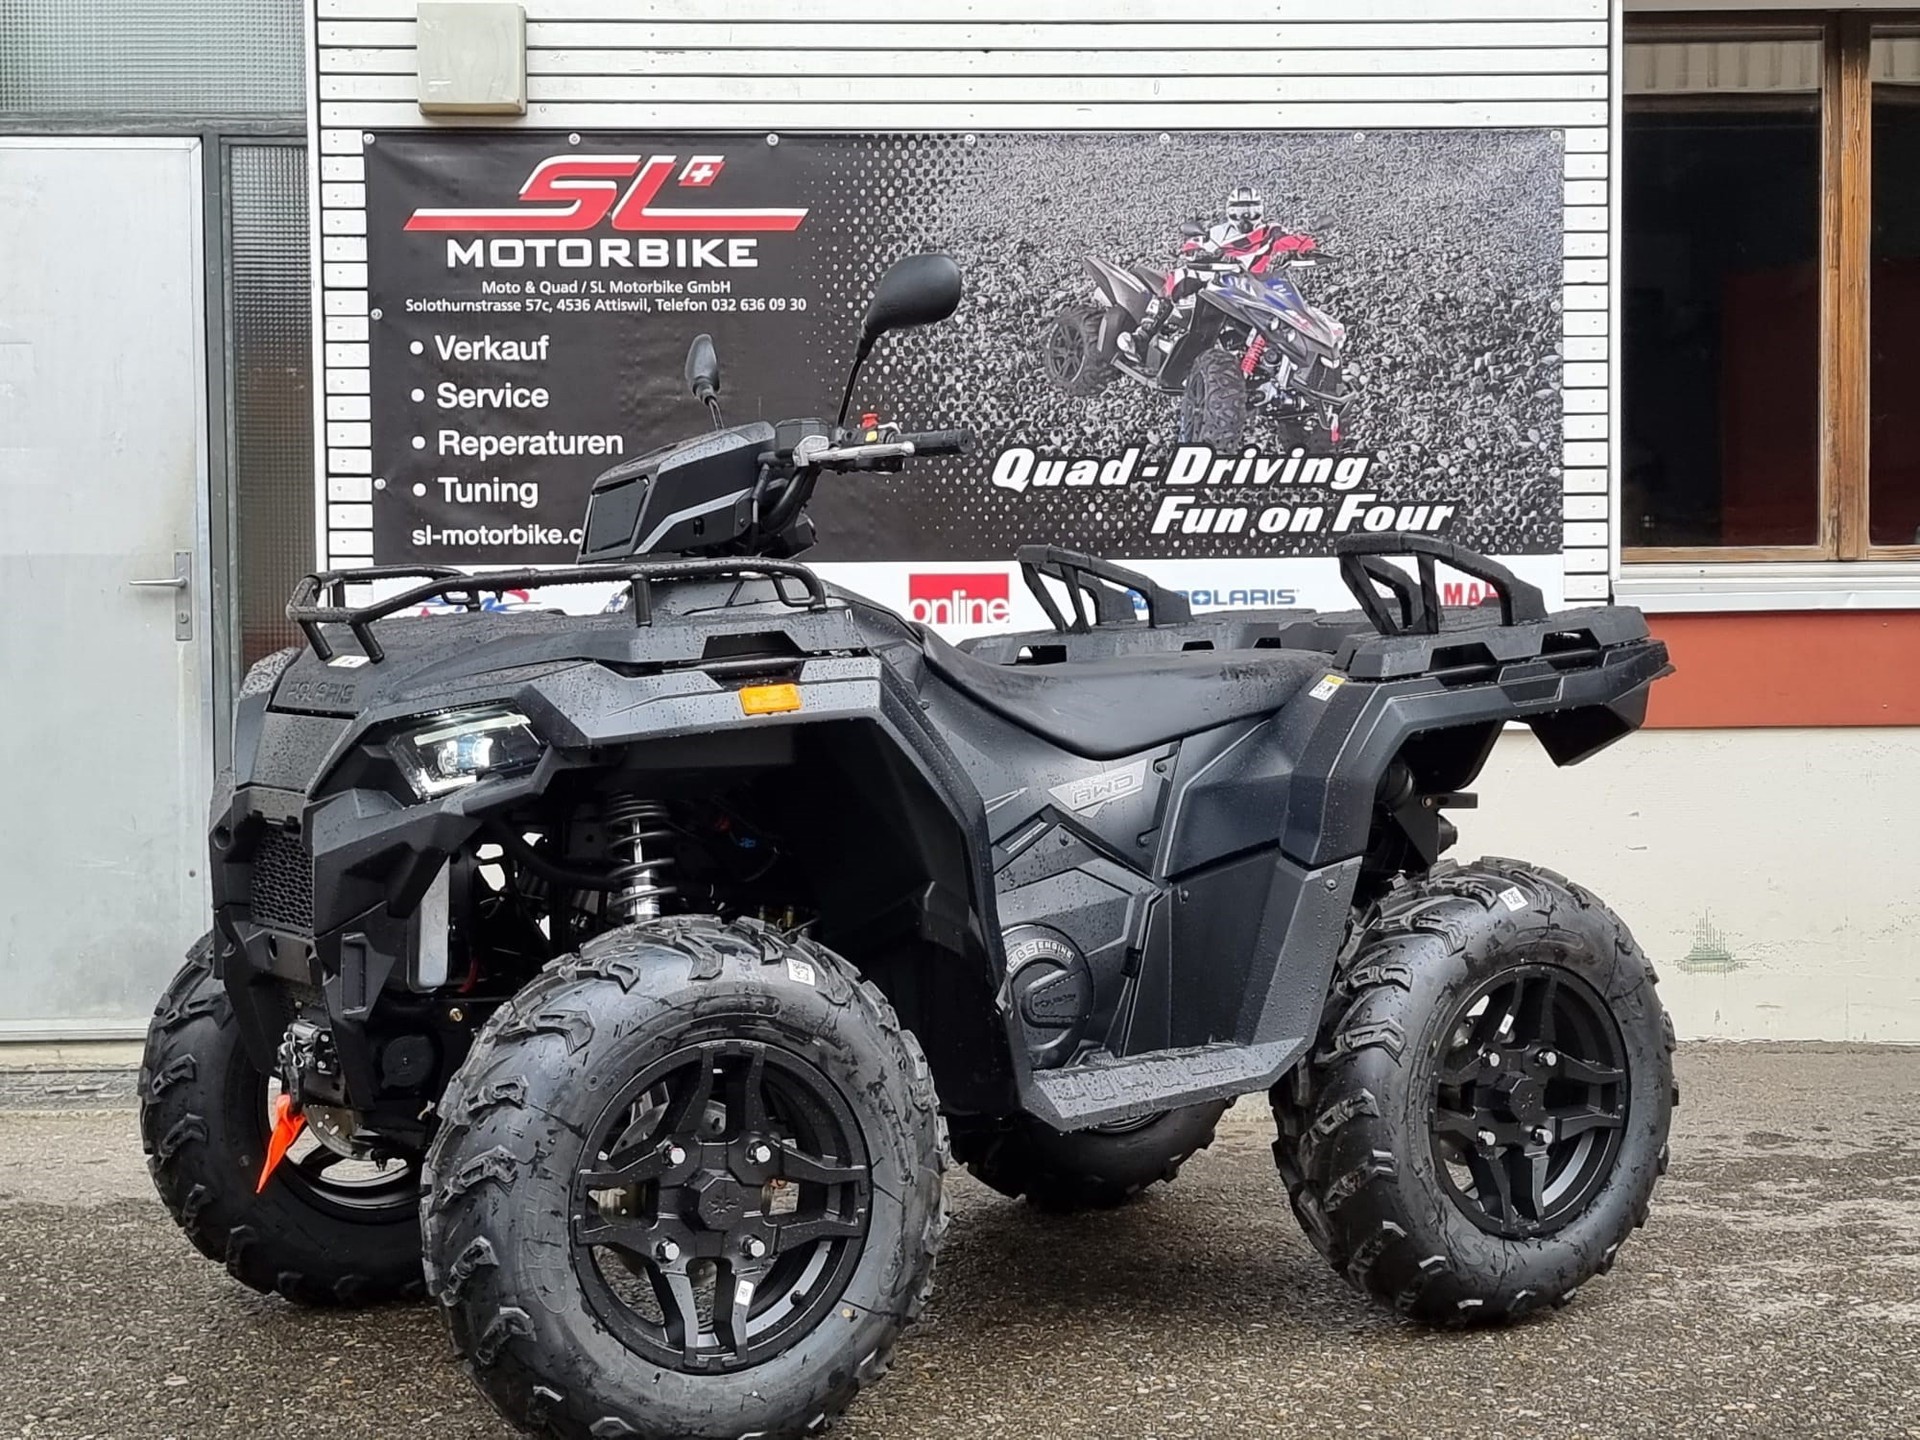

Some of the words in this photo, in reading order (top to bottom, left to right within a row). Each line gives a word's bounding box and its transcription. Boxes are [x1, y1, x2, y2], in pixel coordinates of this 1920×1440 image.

[403, 154, 809, 231] SL
[447, 238, 758, 268] MOTORBIKE
[482, 281, 521, 295] Moto
[525, 281, 536, 295] &
[540, 280, 577, 296] Quad
[590, 281, 606, 295] SL
[610, 280, 684, 295] Motorbike
[687, 280, 731, 295] GmbH
[405, 298, 522, 312] Solothurnstrasse
[525, 298, 553, 314] 57c,
[556, 298, 591, 312] 4536
[594, 298, 652, 313] Attiswil,
[655, 298, 708, 312] Telefon
[711, 298, 737, 312] 032
[740, 298, 766, 312] 636
[769, 298, 786, 312] 09
[790, 298, 807, 312] 30
[434, 334, 550, 361] Verkauf
[436, 383, 549, 408] Service
[438, 430, 624, 461] Reperaturen
[992, 448, 1140, 493] Quad
[1166, 446, 1371, 490] Driving
[438, 477, 539, 508] Tuning
[1151, 496, 1251, 534] Fun
[1257, 506, 1326, 533] on
[1333, 494, 1456, 532] Four
[412, 525, 583, 546] sl-motorbike.c
[909, 589, 1010, 625] online
